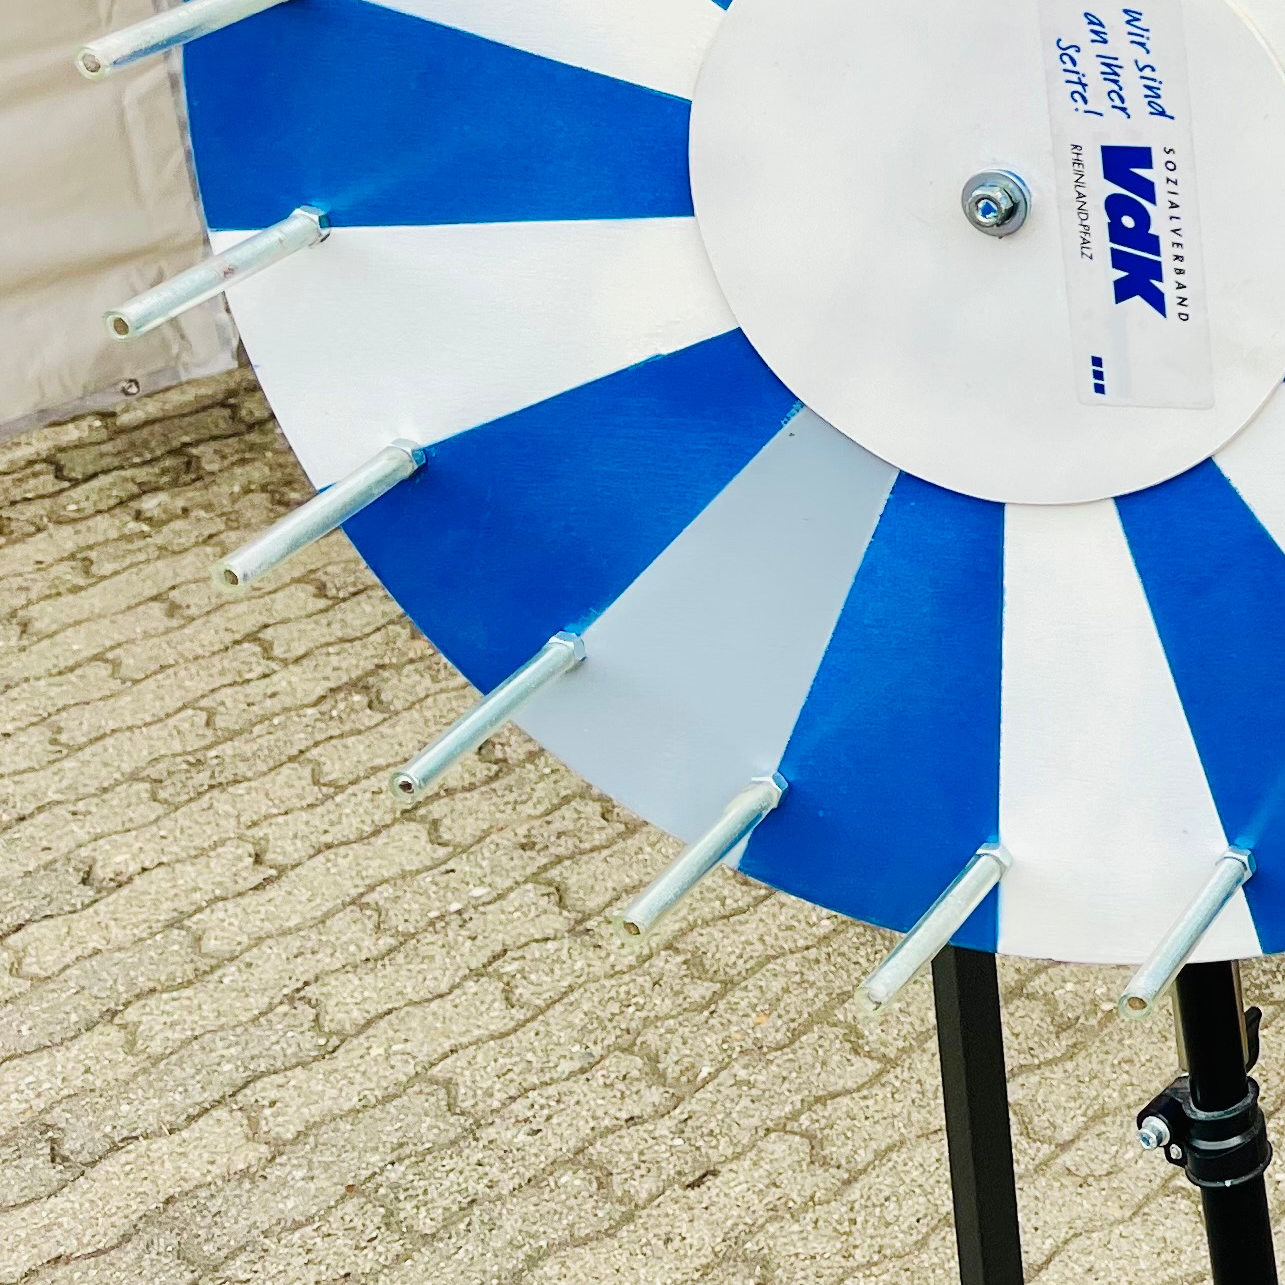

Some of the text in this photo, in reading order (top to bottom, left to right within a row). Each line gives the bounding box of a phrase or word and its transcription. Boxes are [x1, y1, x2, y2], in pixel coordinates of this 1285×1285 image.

[1056, 37, 1104, 118] Seite!
[1083, 11, 1132, 120] an Ihrer
[1121, 7, 1175, 121] Wir sind
[1069, 143, 1094, 262] RHEINLAND-PFALZ
[1099, 144, 1168, 319] VdK
[1163, 146, 1190, 323] SOZIALVERBAND
